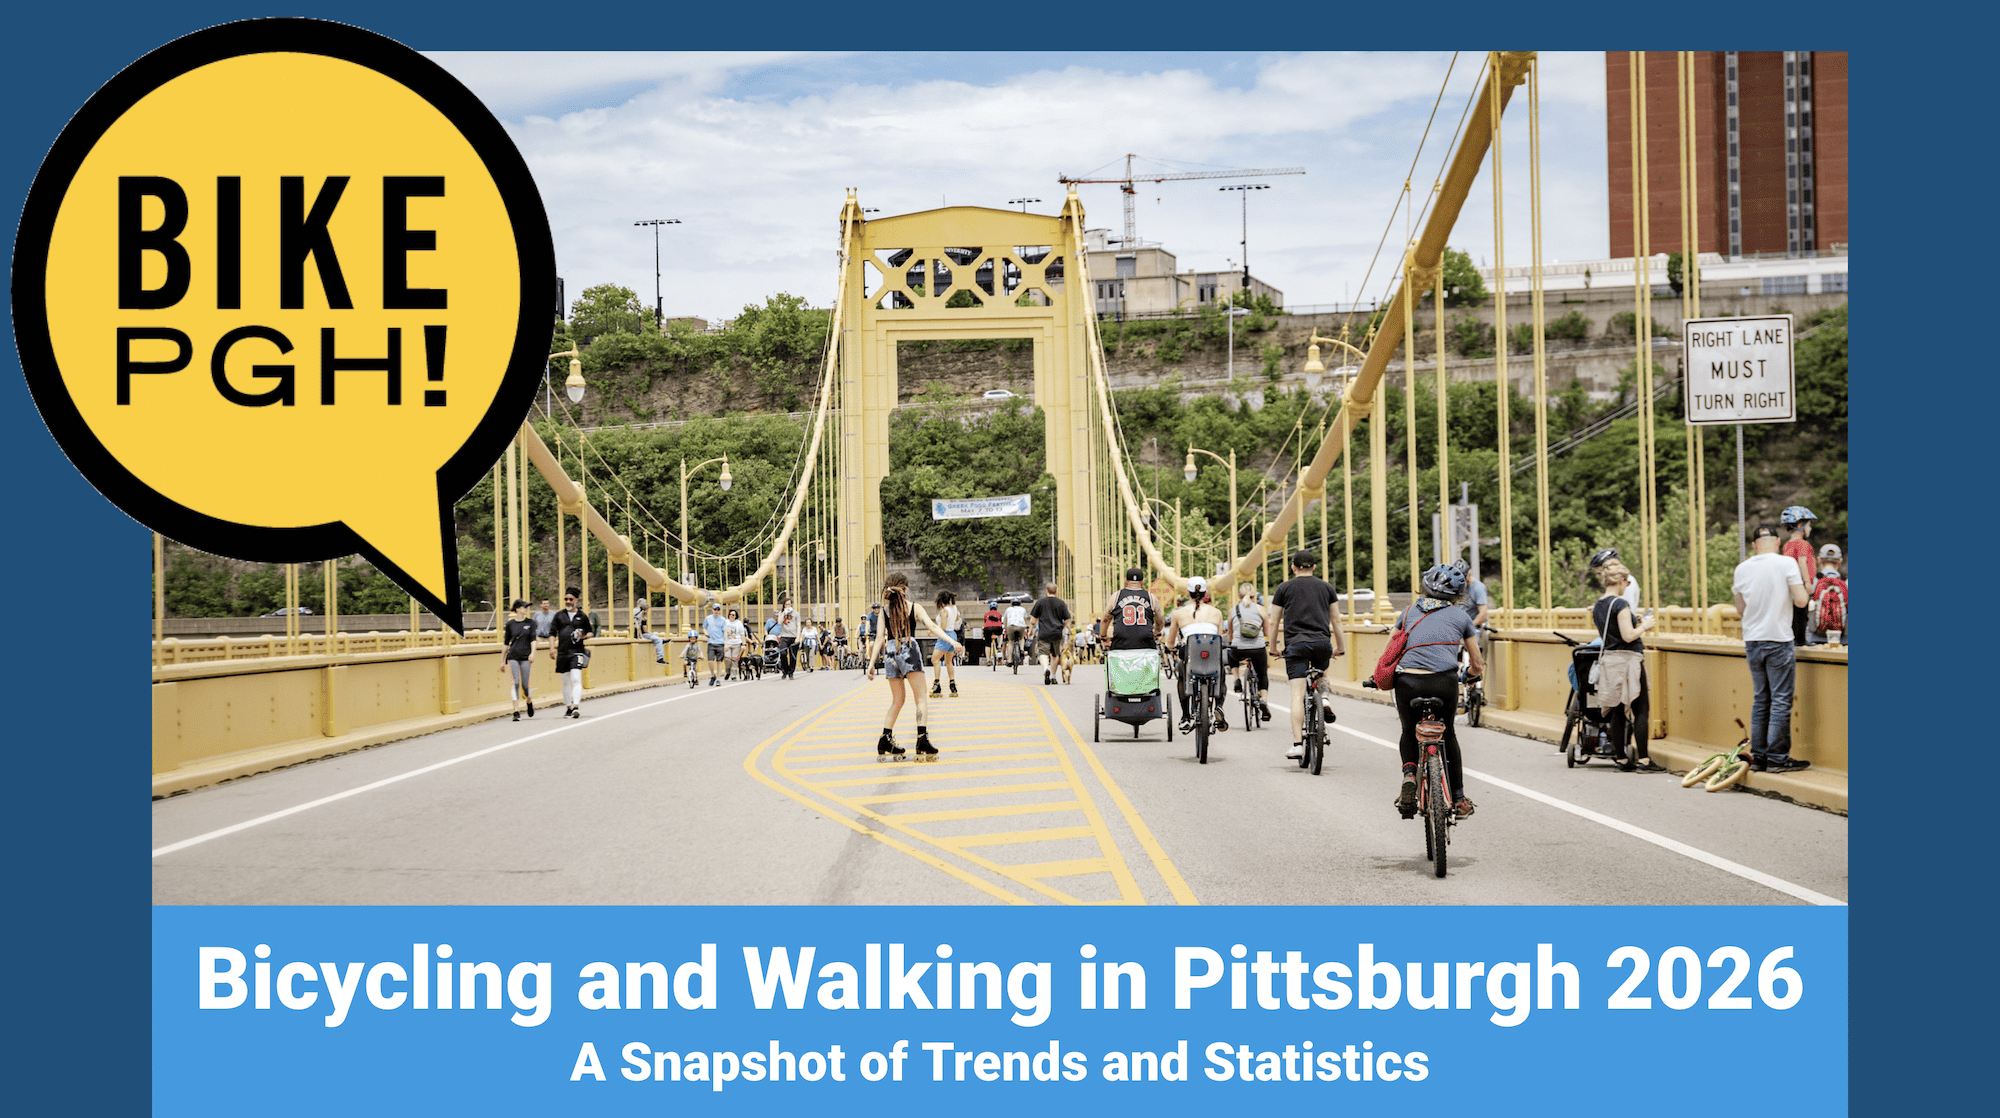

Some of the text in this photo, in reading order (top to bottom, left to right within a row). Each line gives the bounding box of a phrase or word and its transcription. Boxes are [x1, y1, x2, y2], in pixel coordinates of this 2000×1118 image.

[1692, 329, 1784, 348] RIGHT LANE
[1711, 359, 1767, 379] MUST
[1694, 391, 1786, 410] TURN RIGHT
[1122, 604, 1147, 626] 91
